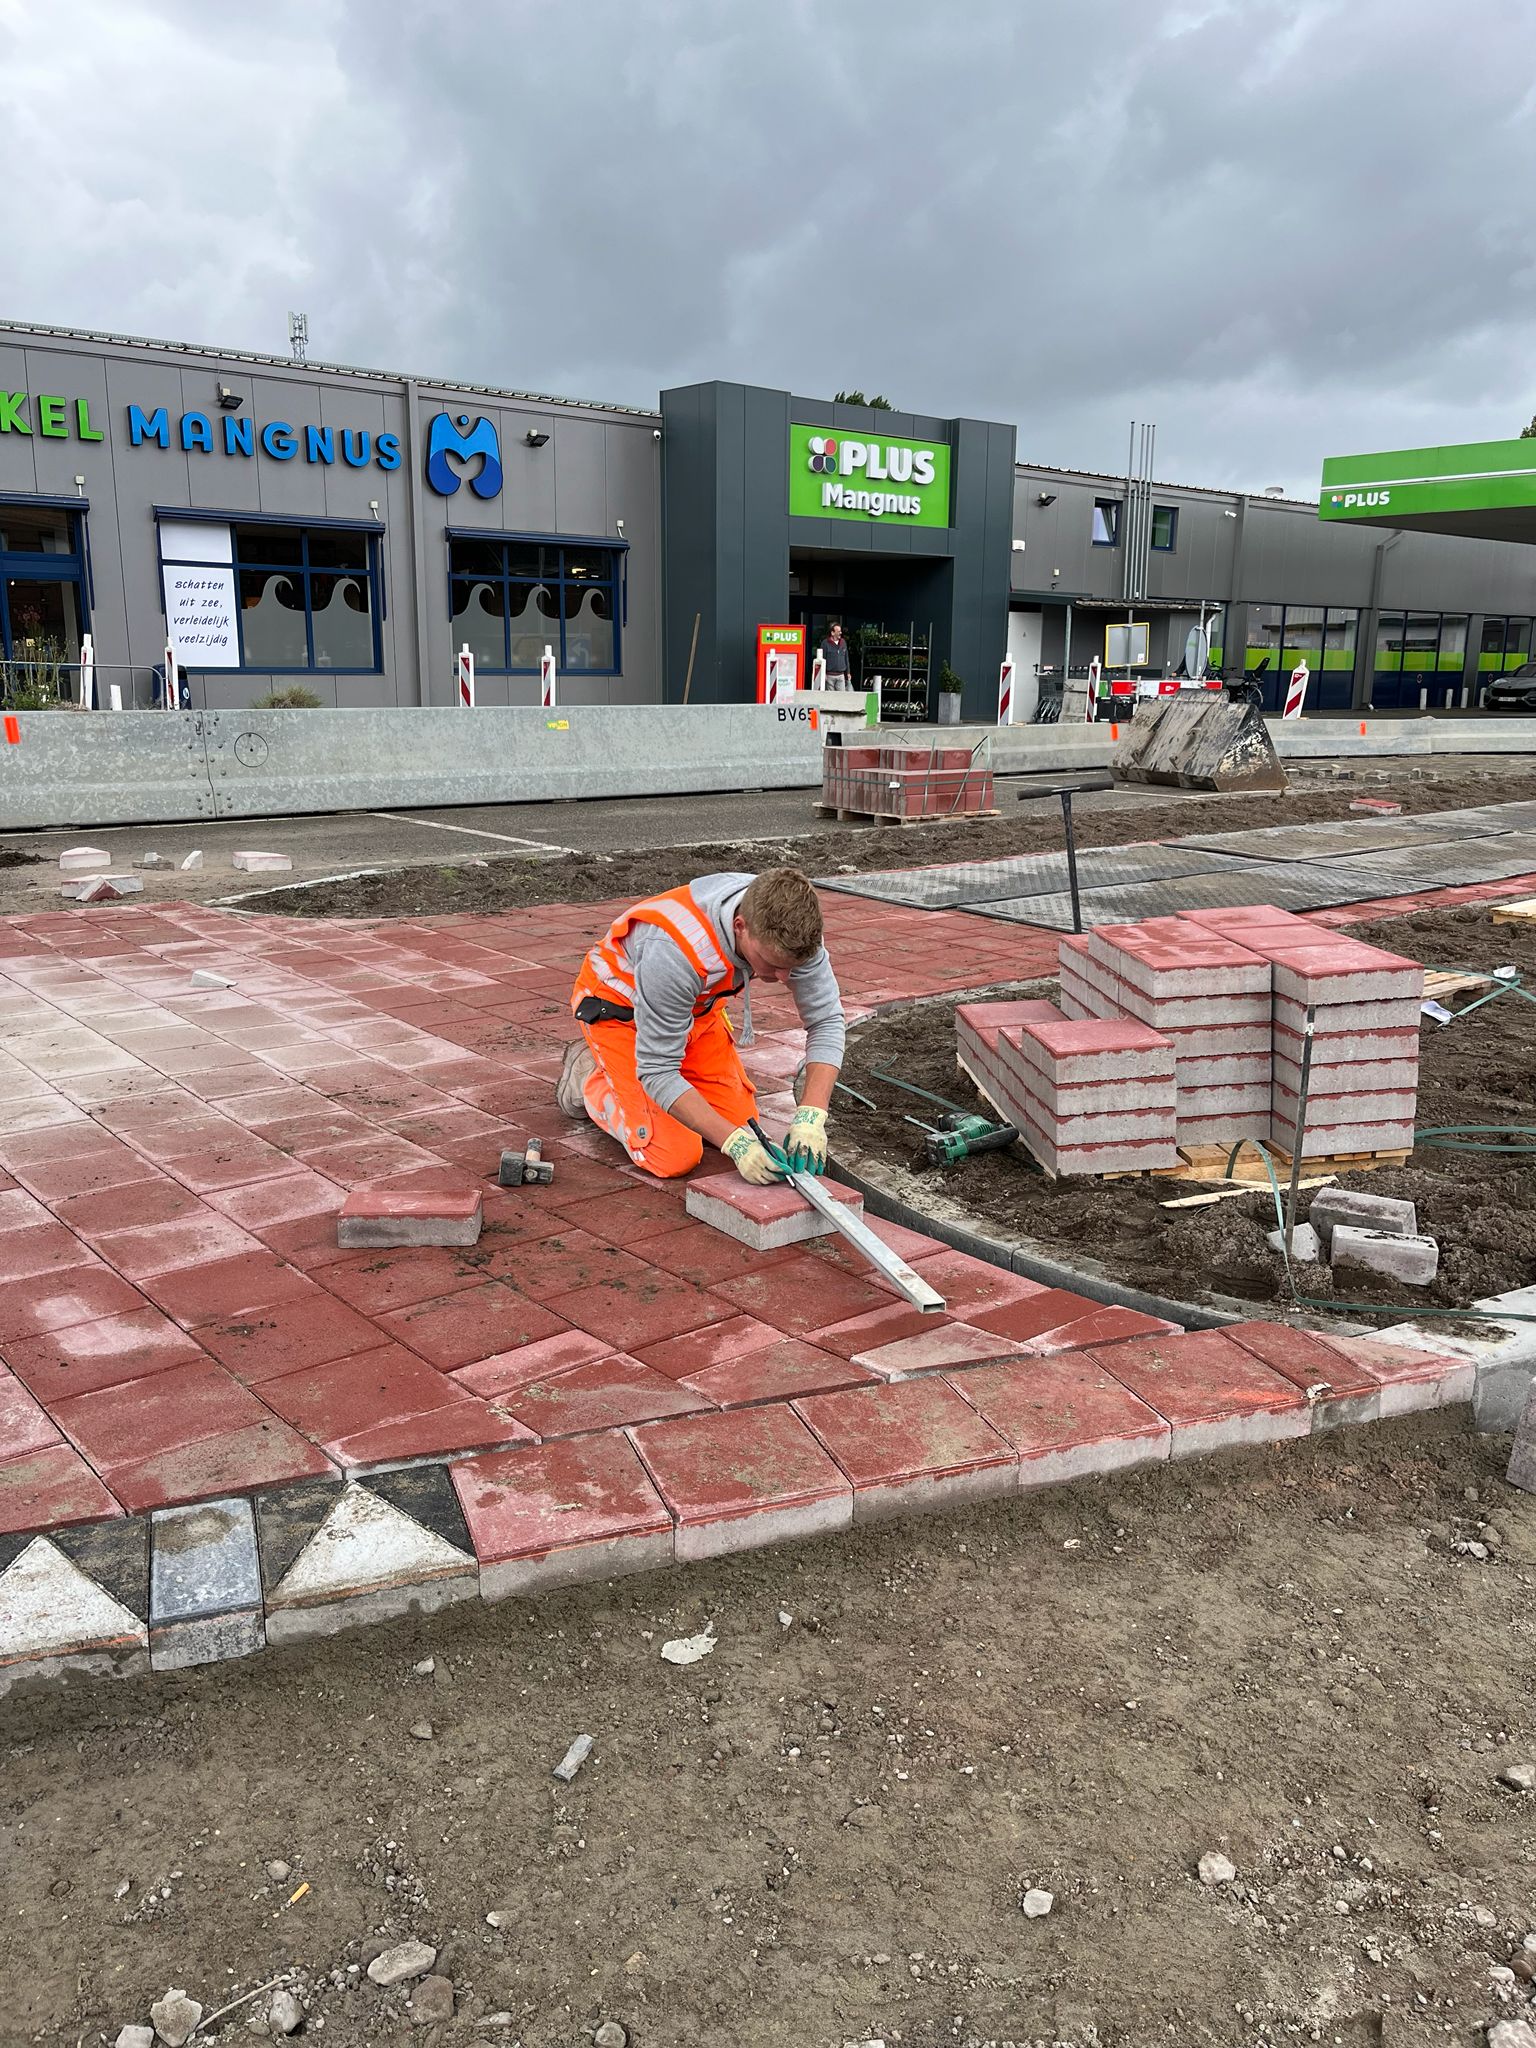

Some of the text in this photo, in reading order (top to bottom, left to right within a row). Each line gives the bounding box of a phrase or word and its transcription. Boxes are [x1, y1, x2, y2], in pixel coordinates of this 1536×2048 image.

[0, 391, 402, 471] KEL MANGNUS
[839, 440, 936, 485] PLUS
[822, 482, 921, 516] Mangnus
[1344, 491, 1390, 508] PLUS
[174, 579, 225, 590] schatten
[179, 597, 223, 609] uit zee,
[173, 615, 230, 629] verleidelijk
[178, 634, 229, 647] veelzijdig
[773, 632, 798, 642] PLUS
